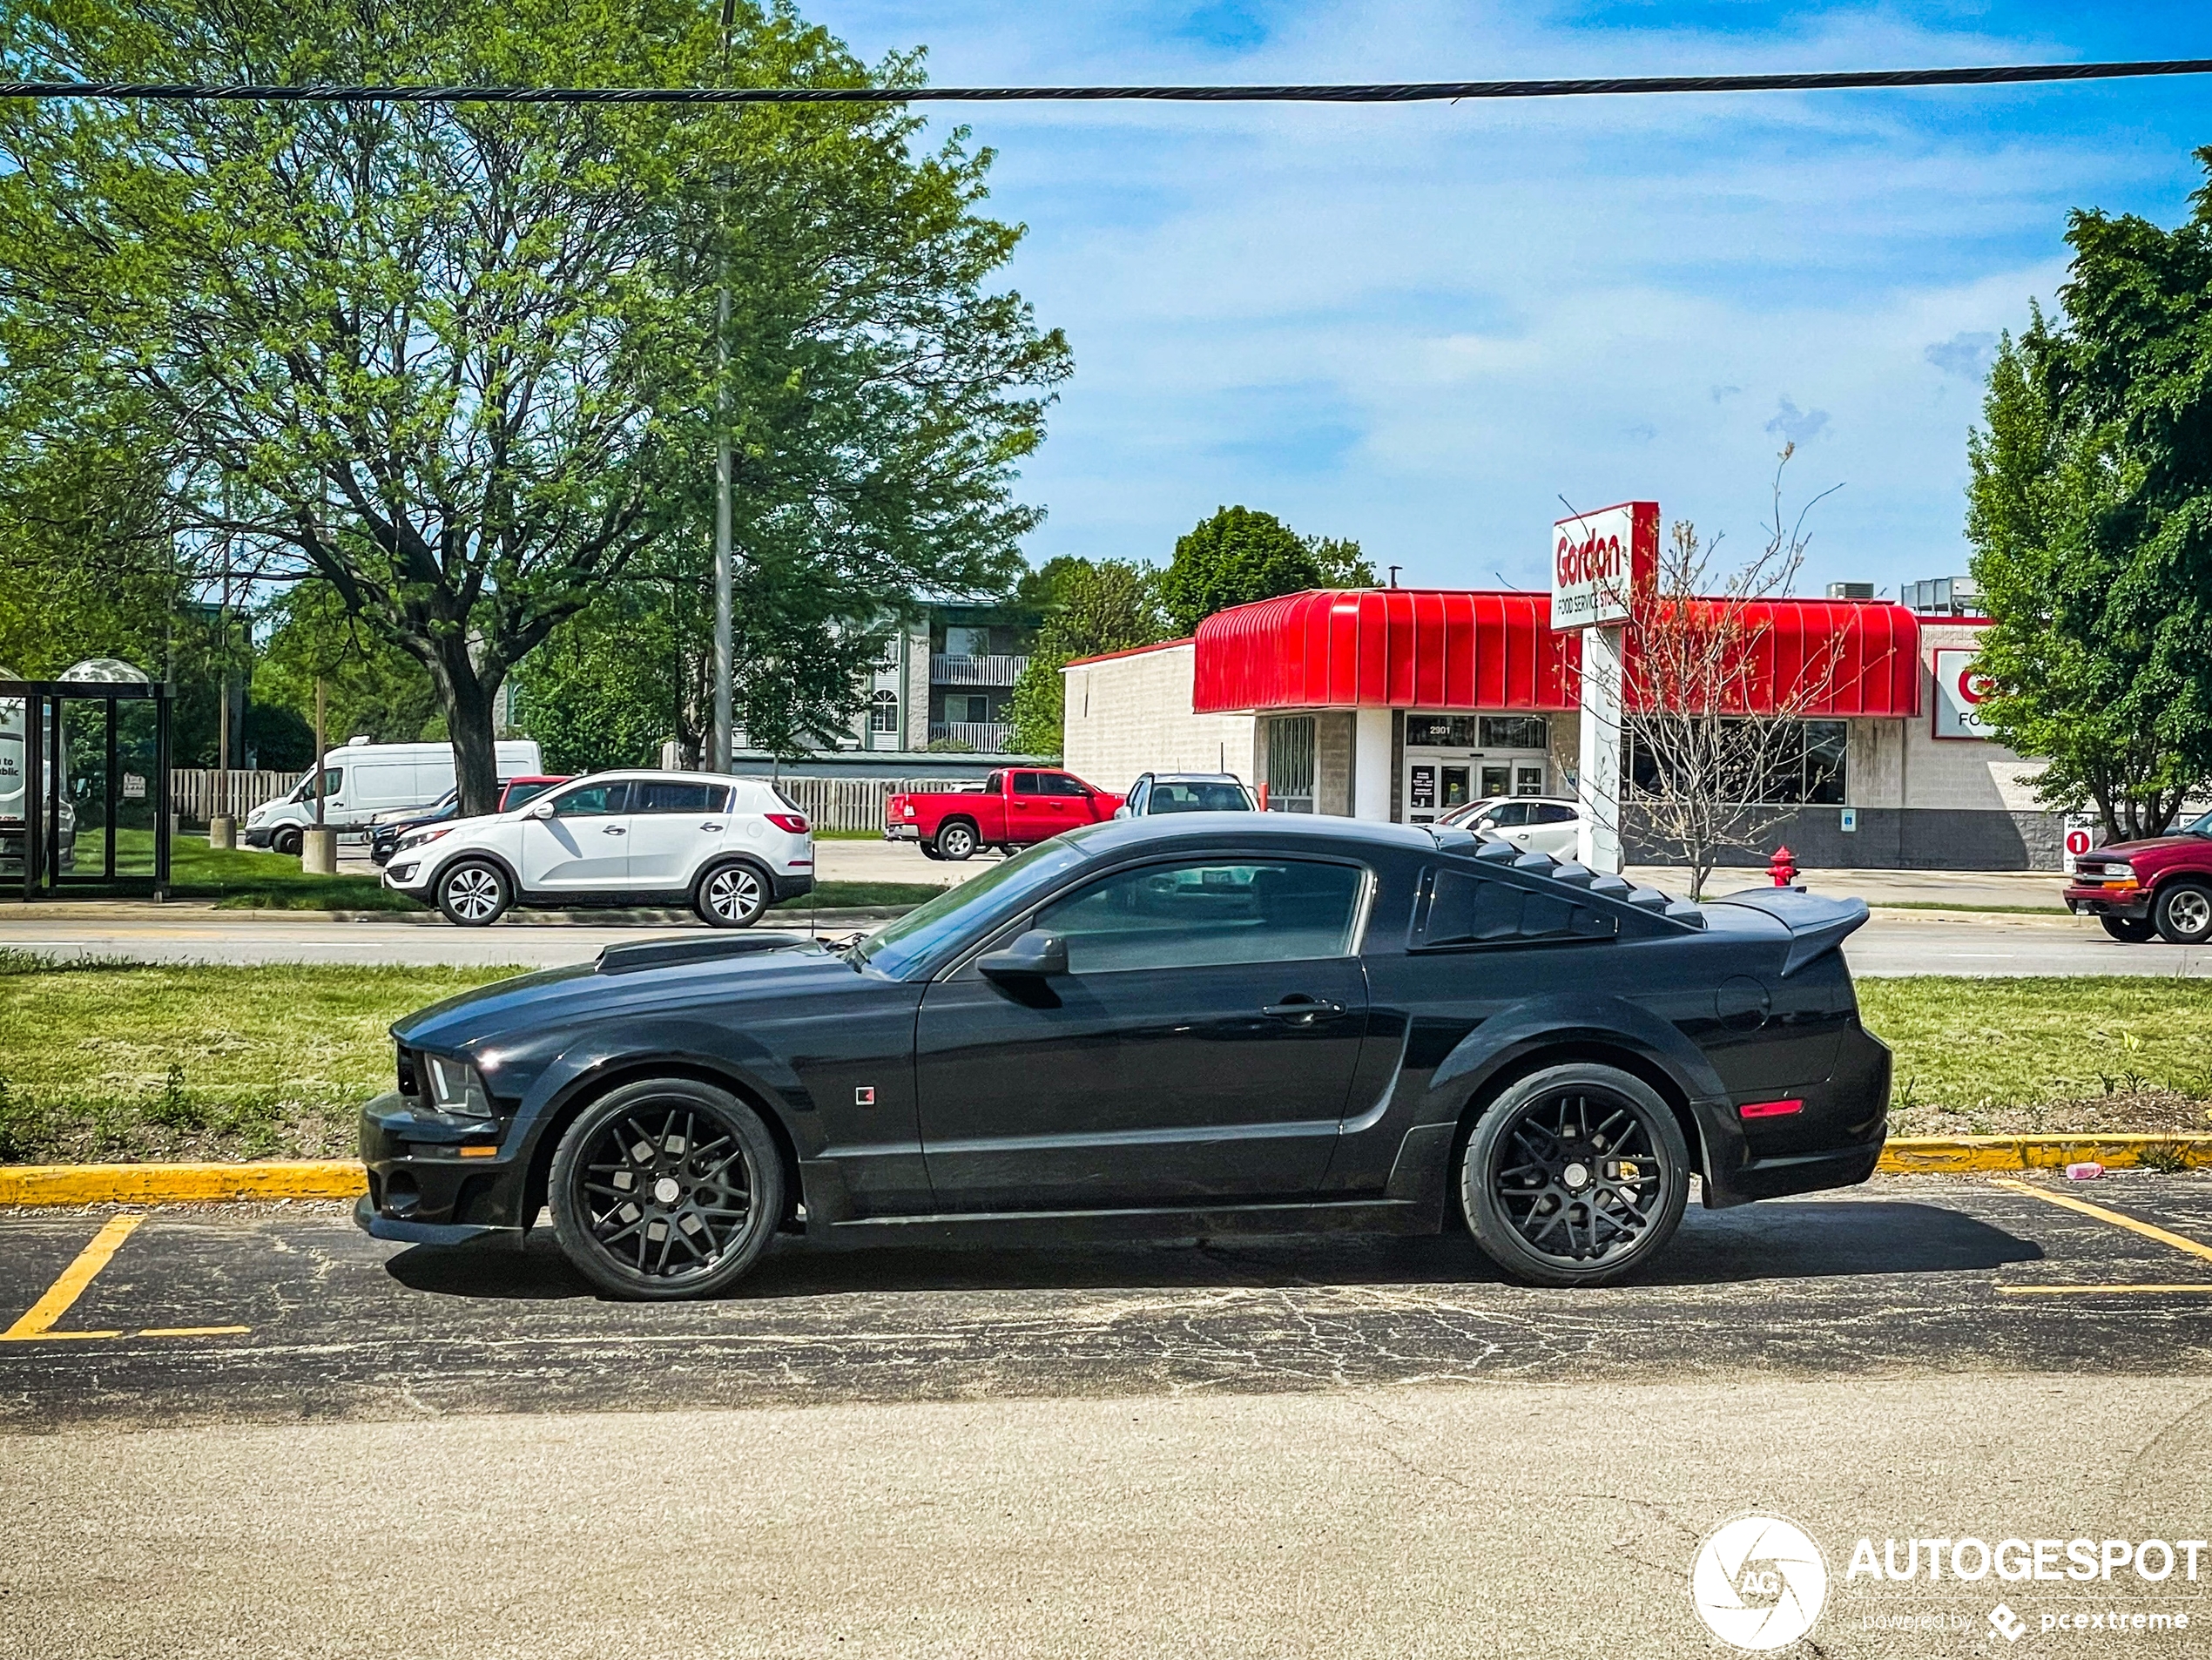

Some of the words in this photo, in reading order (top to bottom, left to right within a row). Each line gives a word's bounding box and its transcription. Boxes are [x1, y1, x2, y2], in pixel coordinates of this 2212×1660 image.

[1557, 528, 1620, 588] Gordon
[1558, 597, 1573, 615] FOOD
[1575, 593, 1598, 612] SERVICE
[2074, 834, 2082, 852] 1
